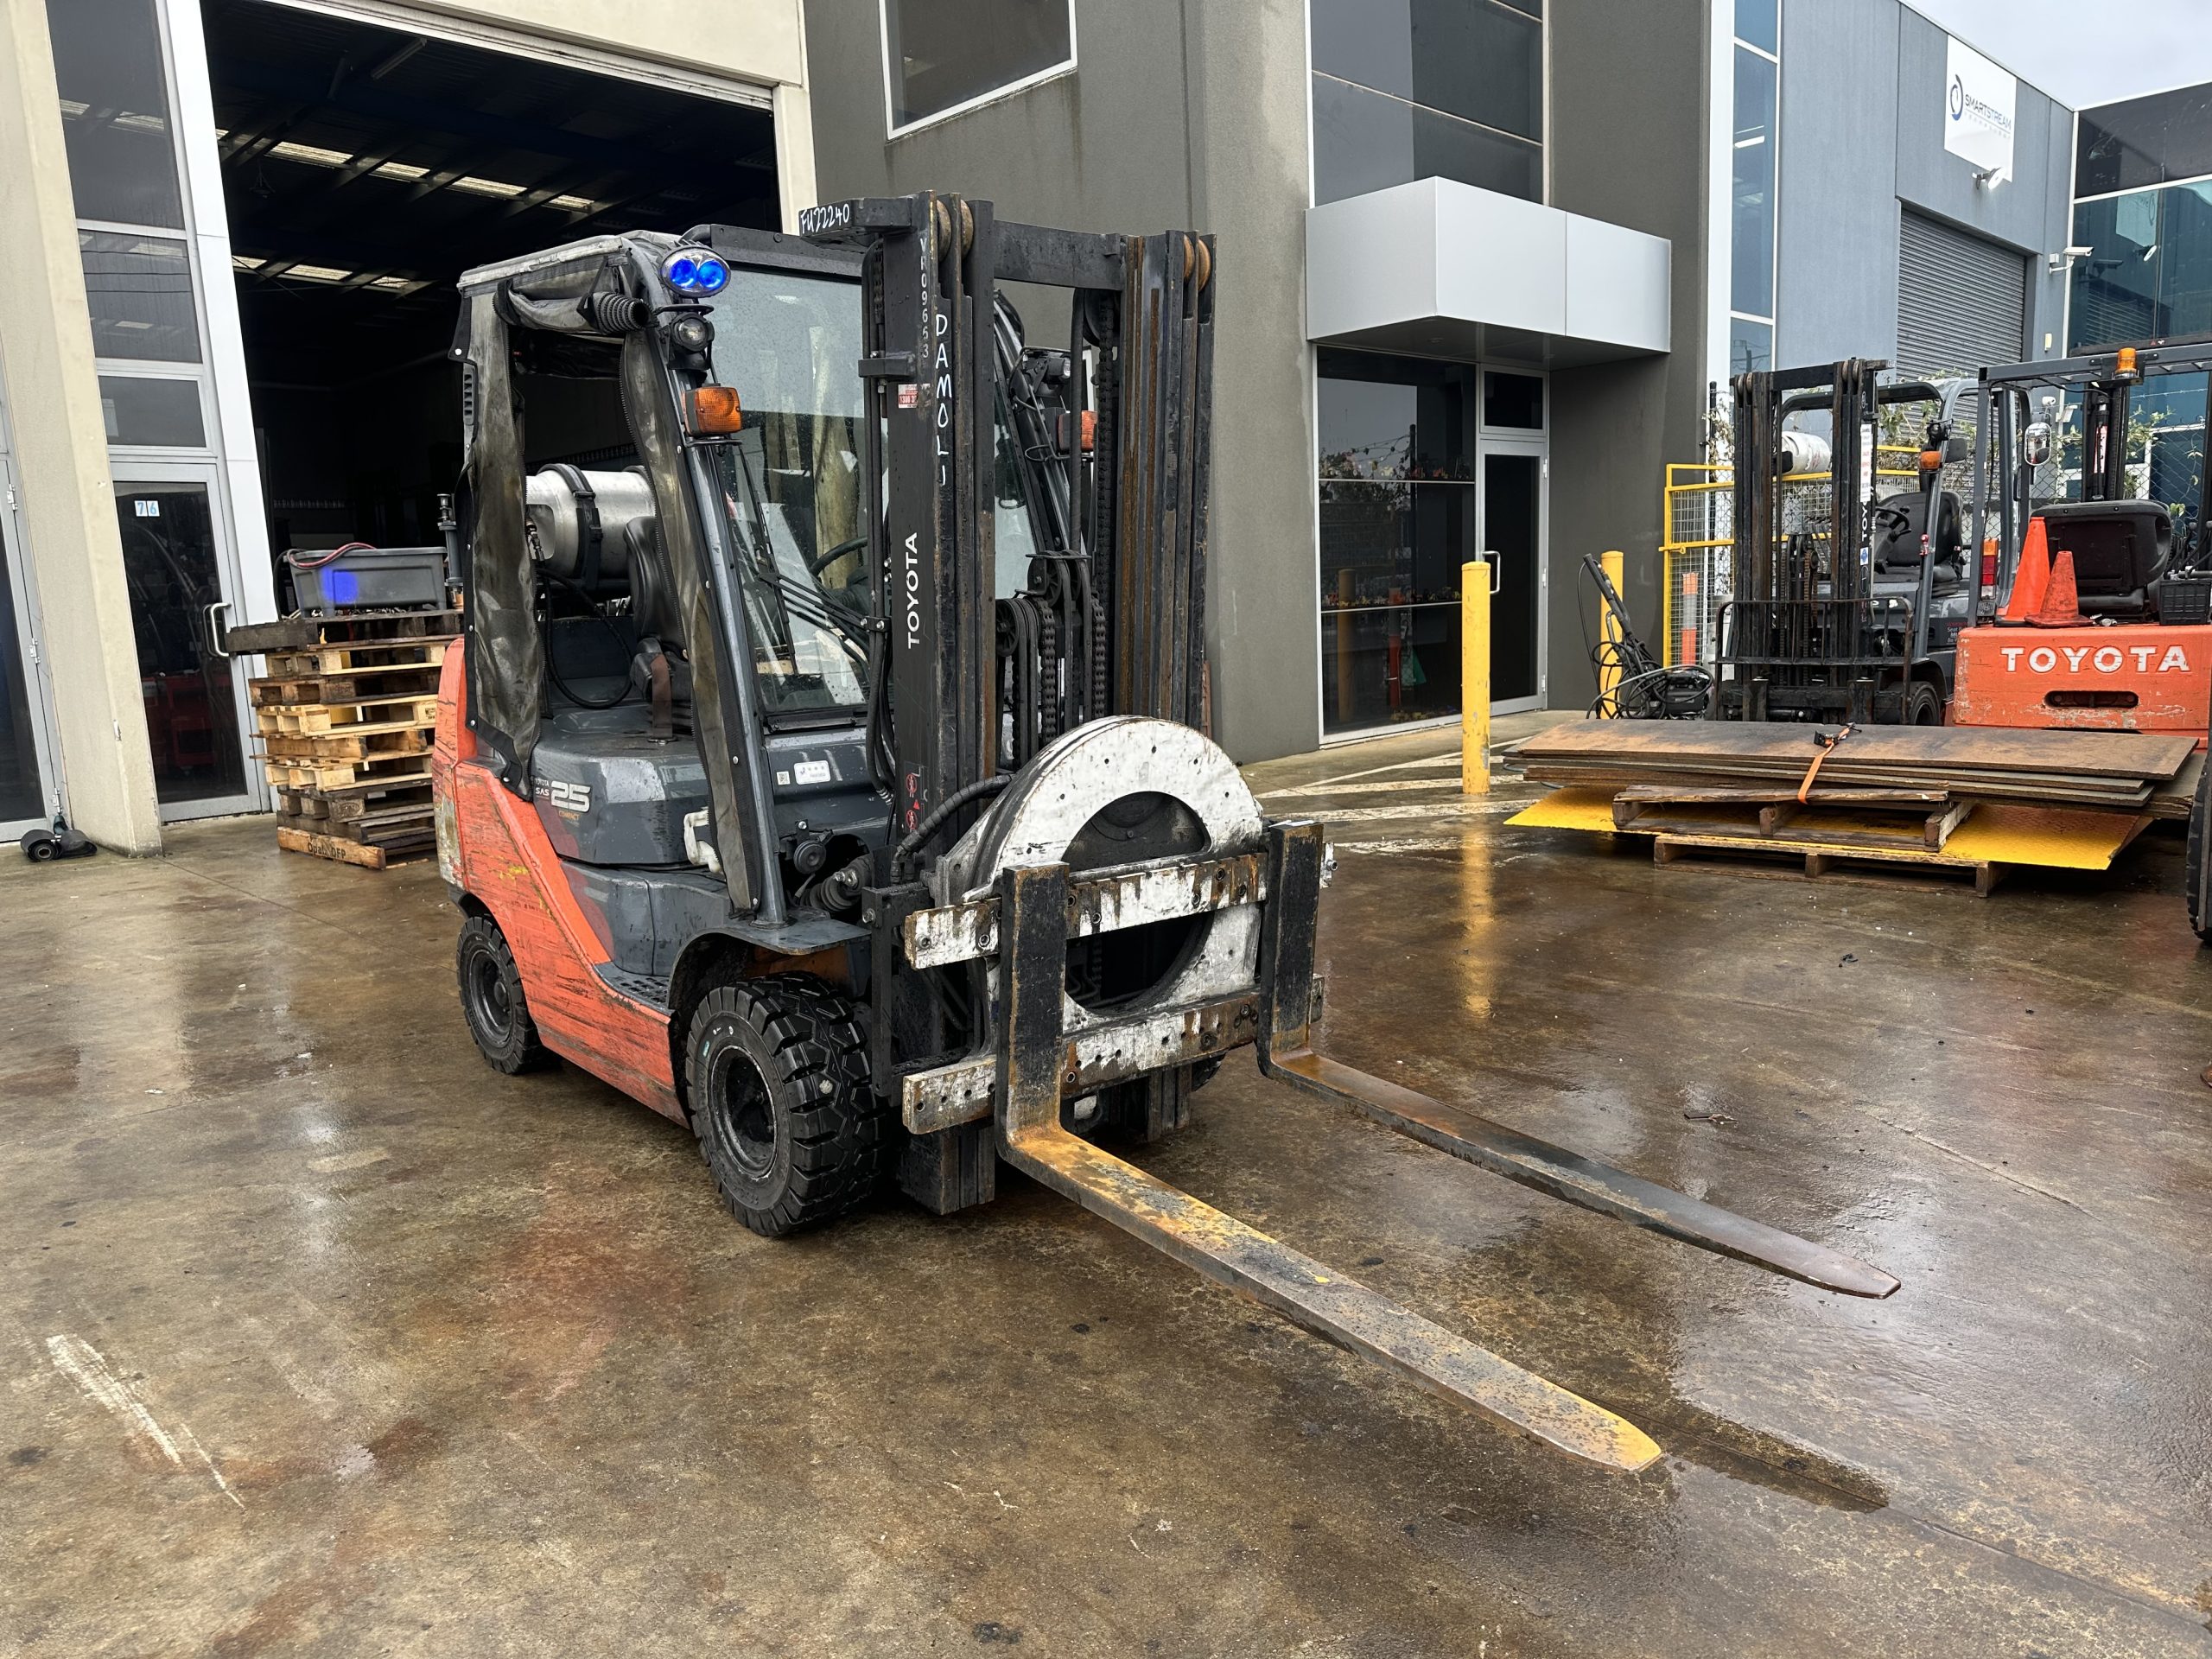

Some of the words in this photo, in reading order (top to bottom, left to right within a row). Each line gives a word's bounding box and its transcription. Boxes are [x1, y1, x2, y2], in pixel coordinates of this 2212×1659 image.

[1965, 93, 2012, 130] SMARTSTREAM
[137, 501, 157, 516] 76
[905, 531, 920, 650] TOYOTA
[2000, 645, 2191, 674] TOYOTA
[535, 787, 550, 797] SAS
[551, 780, 591, 813] 25
